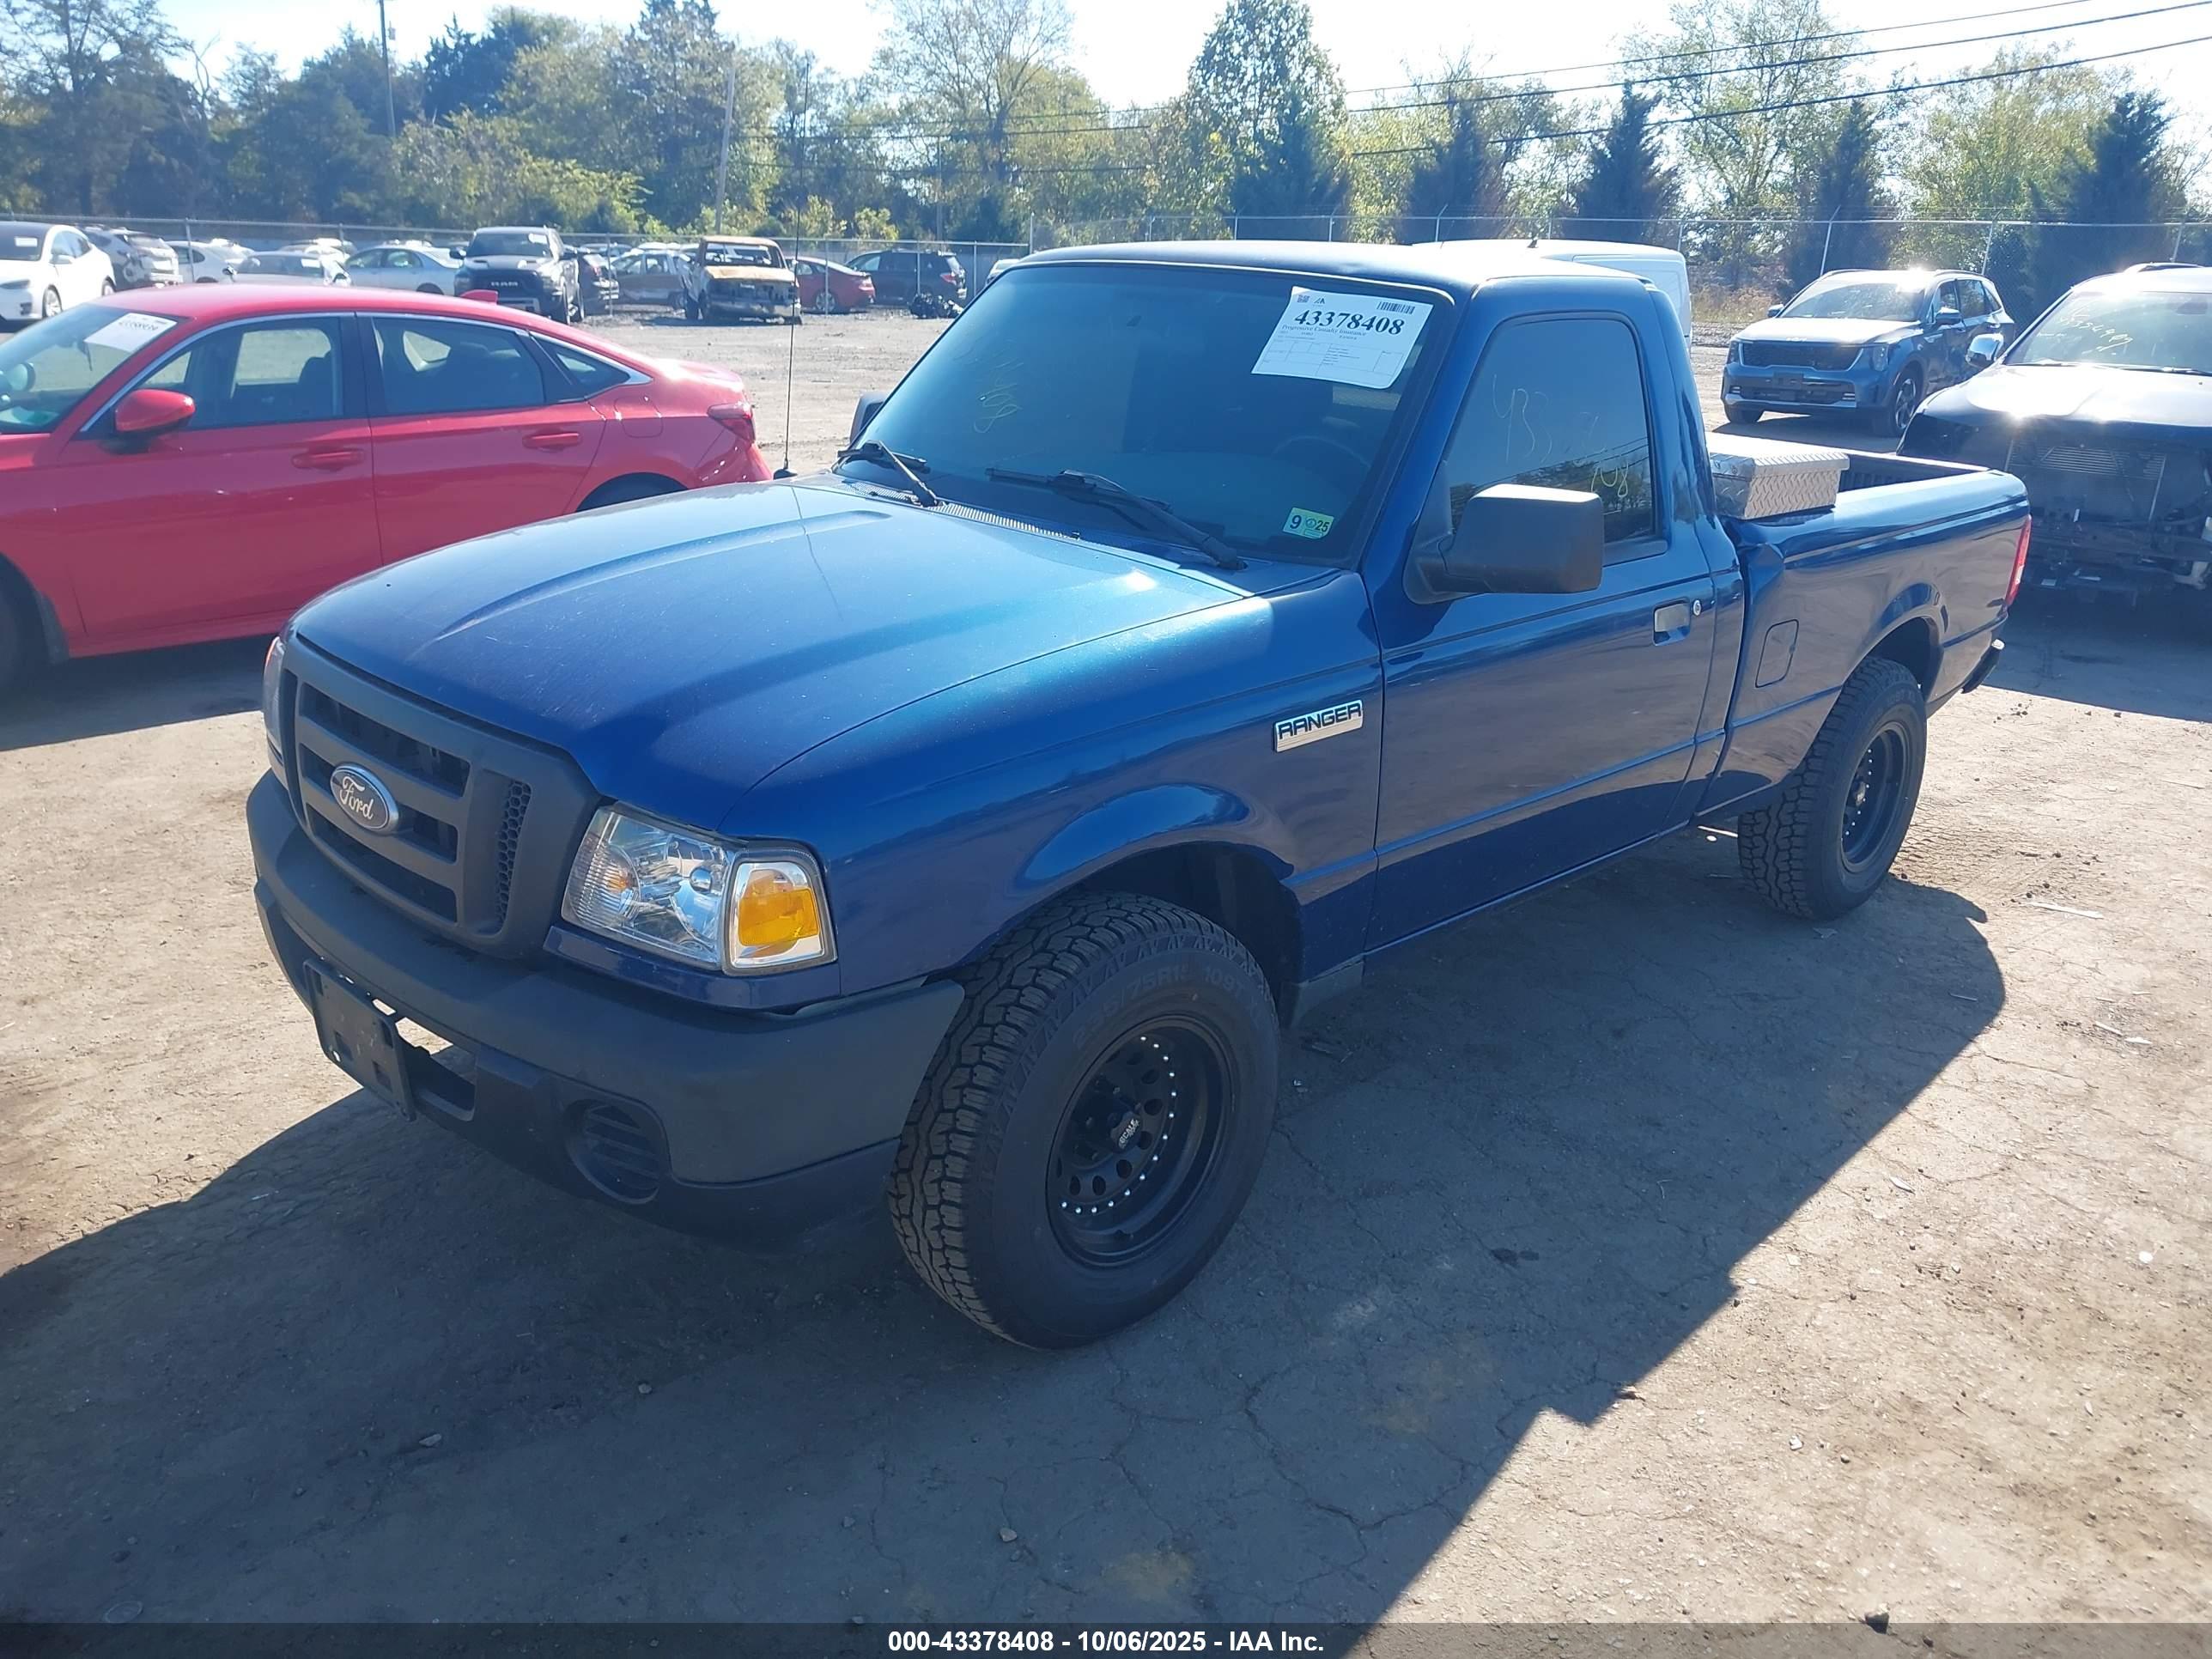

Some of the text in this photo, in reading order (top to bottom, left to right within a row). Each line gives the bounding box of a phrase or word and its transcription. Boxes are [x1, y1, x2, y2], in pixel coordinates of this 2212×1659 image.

[1294, 309, 1405, 335] 43378408
[1290, 515, 1330, 532] 9 25
[1277, 702, 1362, 739] RANGER
[339, 776, 374, 820] Ford
